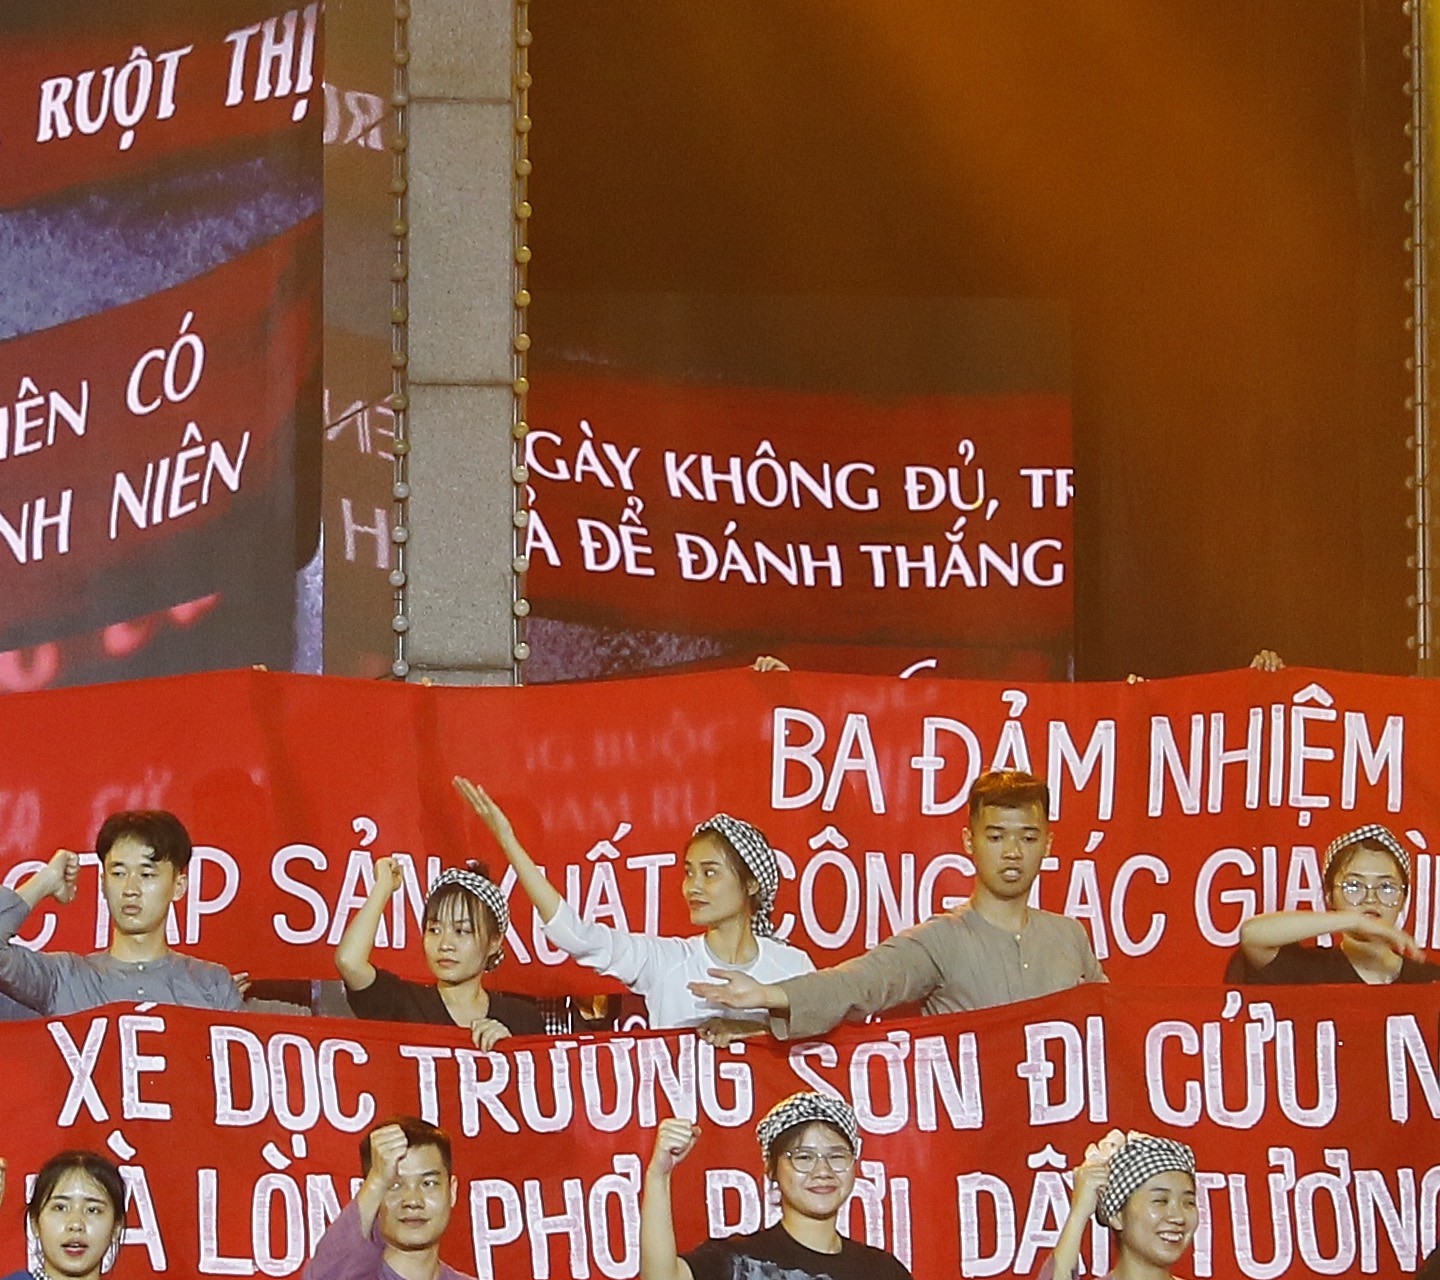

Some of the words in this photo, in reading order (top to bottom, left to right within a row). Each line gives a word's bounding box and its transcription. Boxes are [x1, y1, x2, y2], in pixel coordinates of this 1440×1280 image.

[36, 45, 193, 151] RUỘT
[124, 311, 206, 418] CÓ
[110, 421, 250, 539] NIÊN
[664, 440, 880, 511] KHÔNG
[904, 439, 1001, 522] ĐỦ,
[578, 496, 656, 577] ĐỂ
[675, 521, 842, 588] ĐÁNH
[859, 517, 1066, 589] THẮNG
[771, 707, 885, 814] BA
[911, 690, 1116, 821] ĐẢM
[1147, 683, 1406, 826] NHIỆM
[210, 1022, 377, 1167] DỌC
[787, 1028, 985, 1135] SƠN
[1016, 1014, 1109, 1128] ĐI
[1145, 990, 1337, 1130] CỨU
[197, 1141, 366, 1277] LÒN
